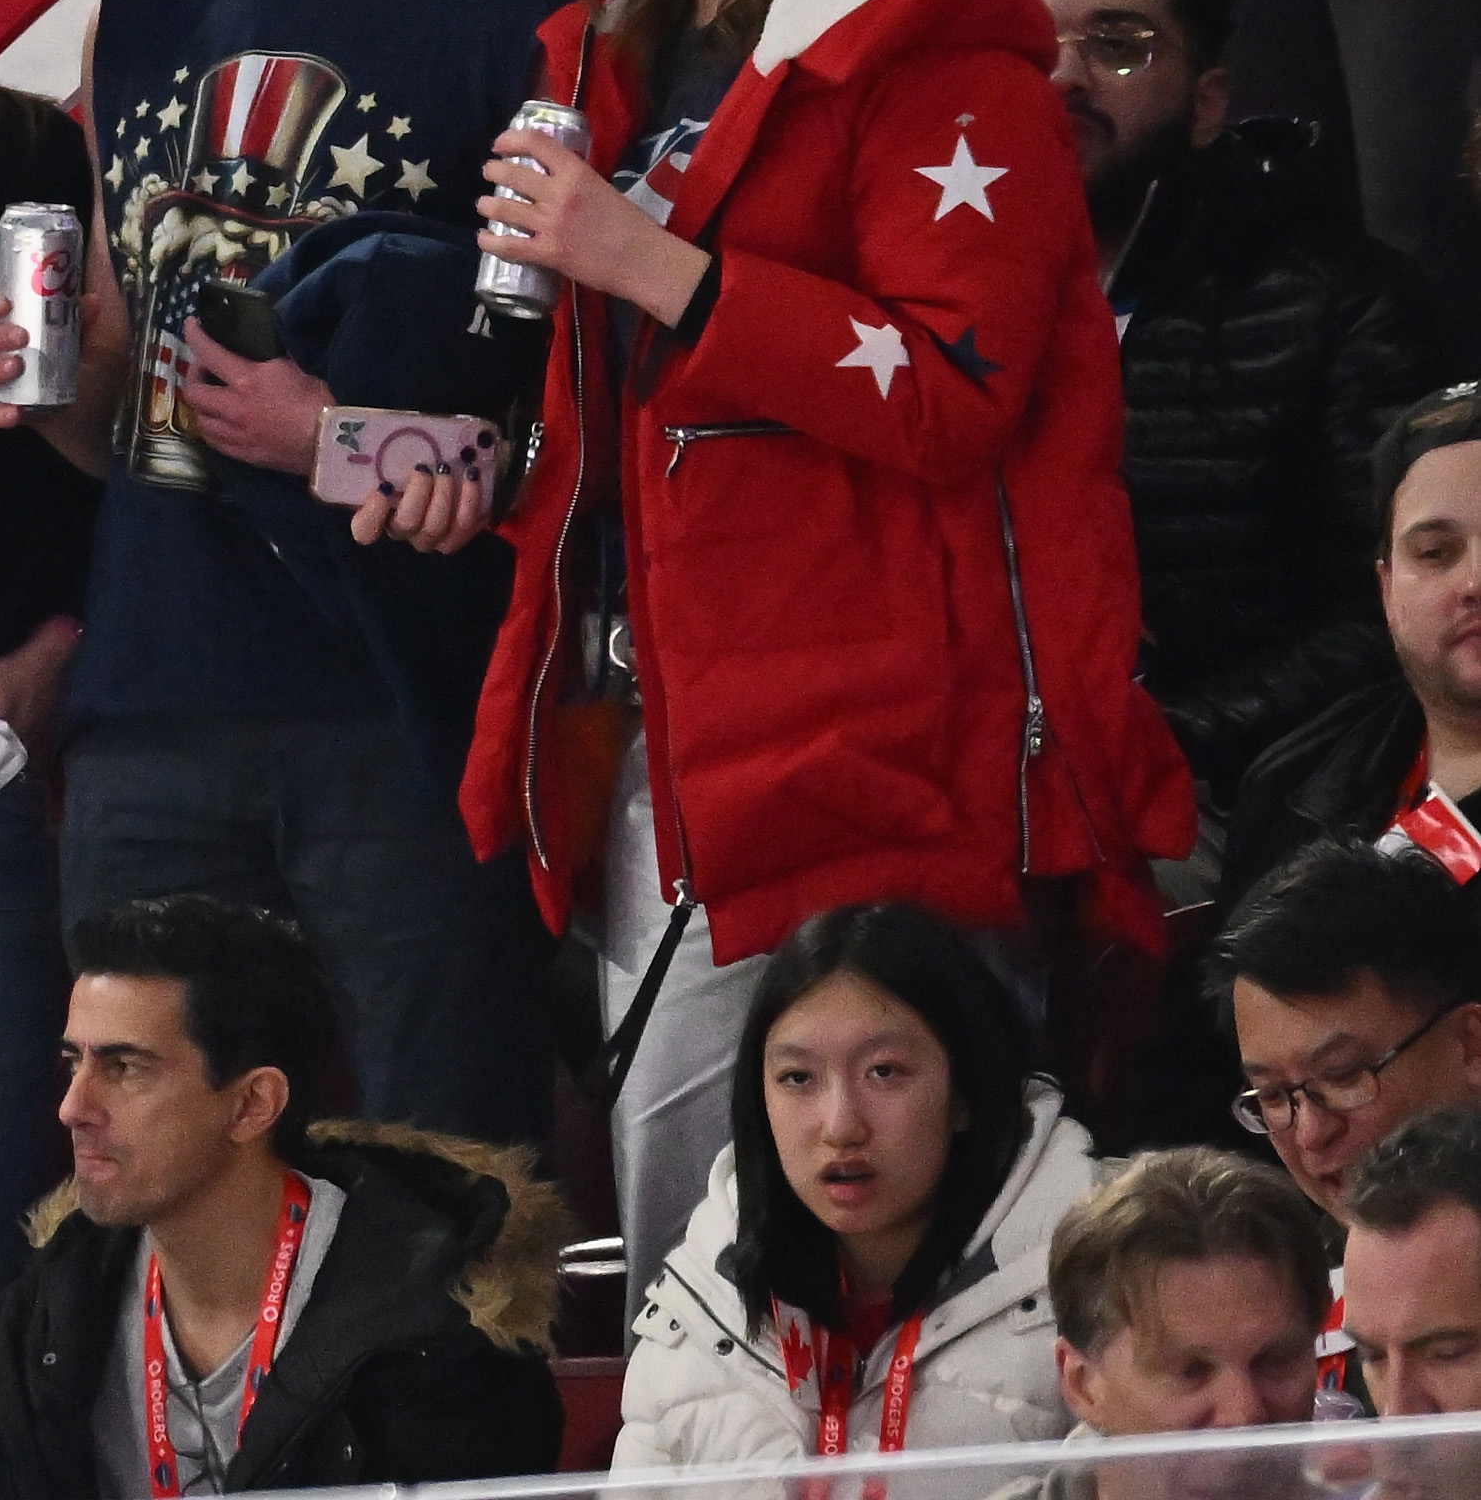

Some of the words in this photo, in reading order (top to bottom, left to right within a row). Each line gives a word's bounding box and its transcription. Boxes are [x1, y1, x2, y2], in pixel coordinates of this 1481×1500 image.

[267, 1241, 295, 1304] ROGERS
[150, 1379, 167, 1442] ROGERS
[886, 1371, 905, 1439] ROGERS
